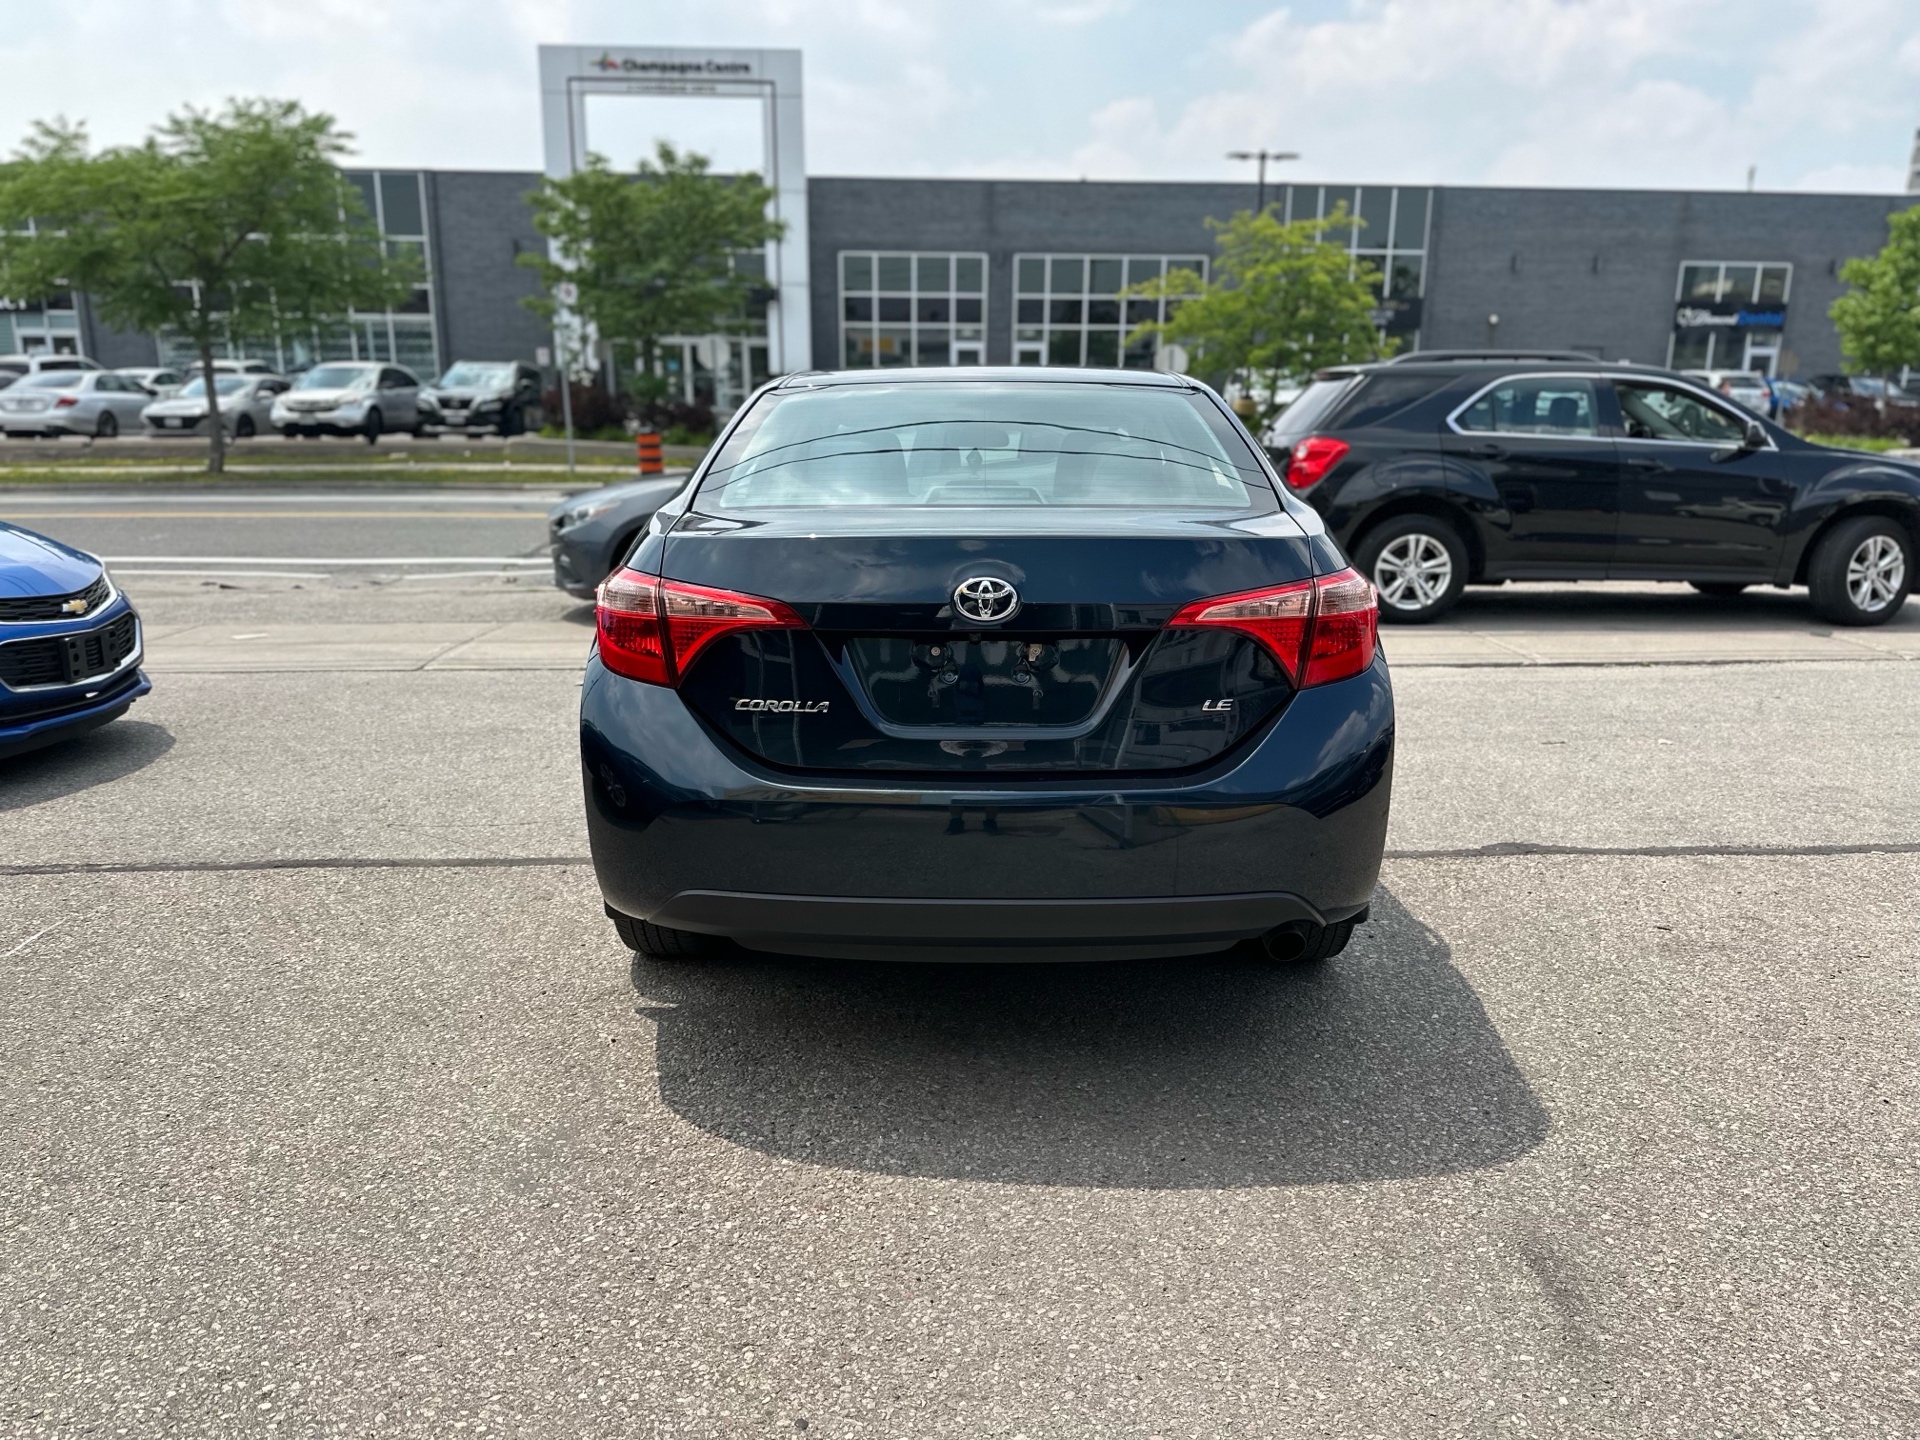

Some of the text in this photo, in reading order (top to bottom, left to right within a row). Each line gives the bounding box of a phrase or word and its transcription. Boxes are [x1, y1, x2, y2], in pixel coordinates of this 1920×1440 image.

[622, 58, 751, 75] Champagne Centre
[735, 699, 829, 713] COROLLA
[1202, 699, 1234, 711] LE
